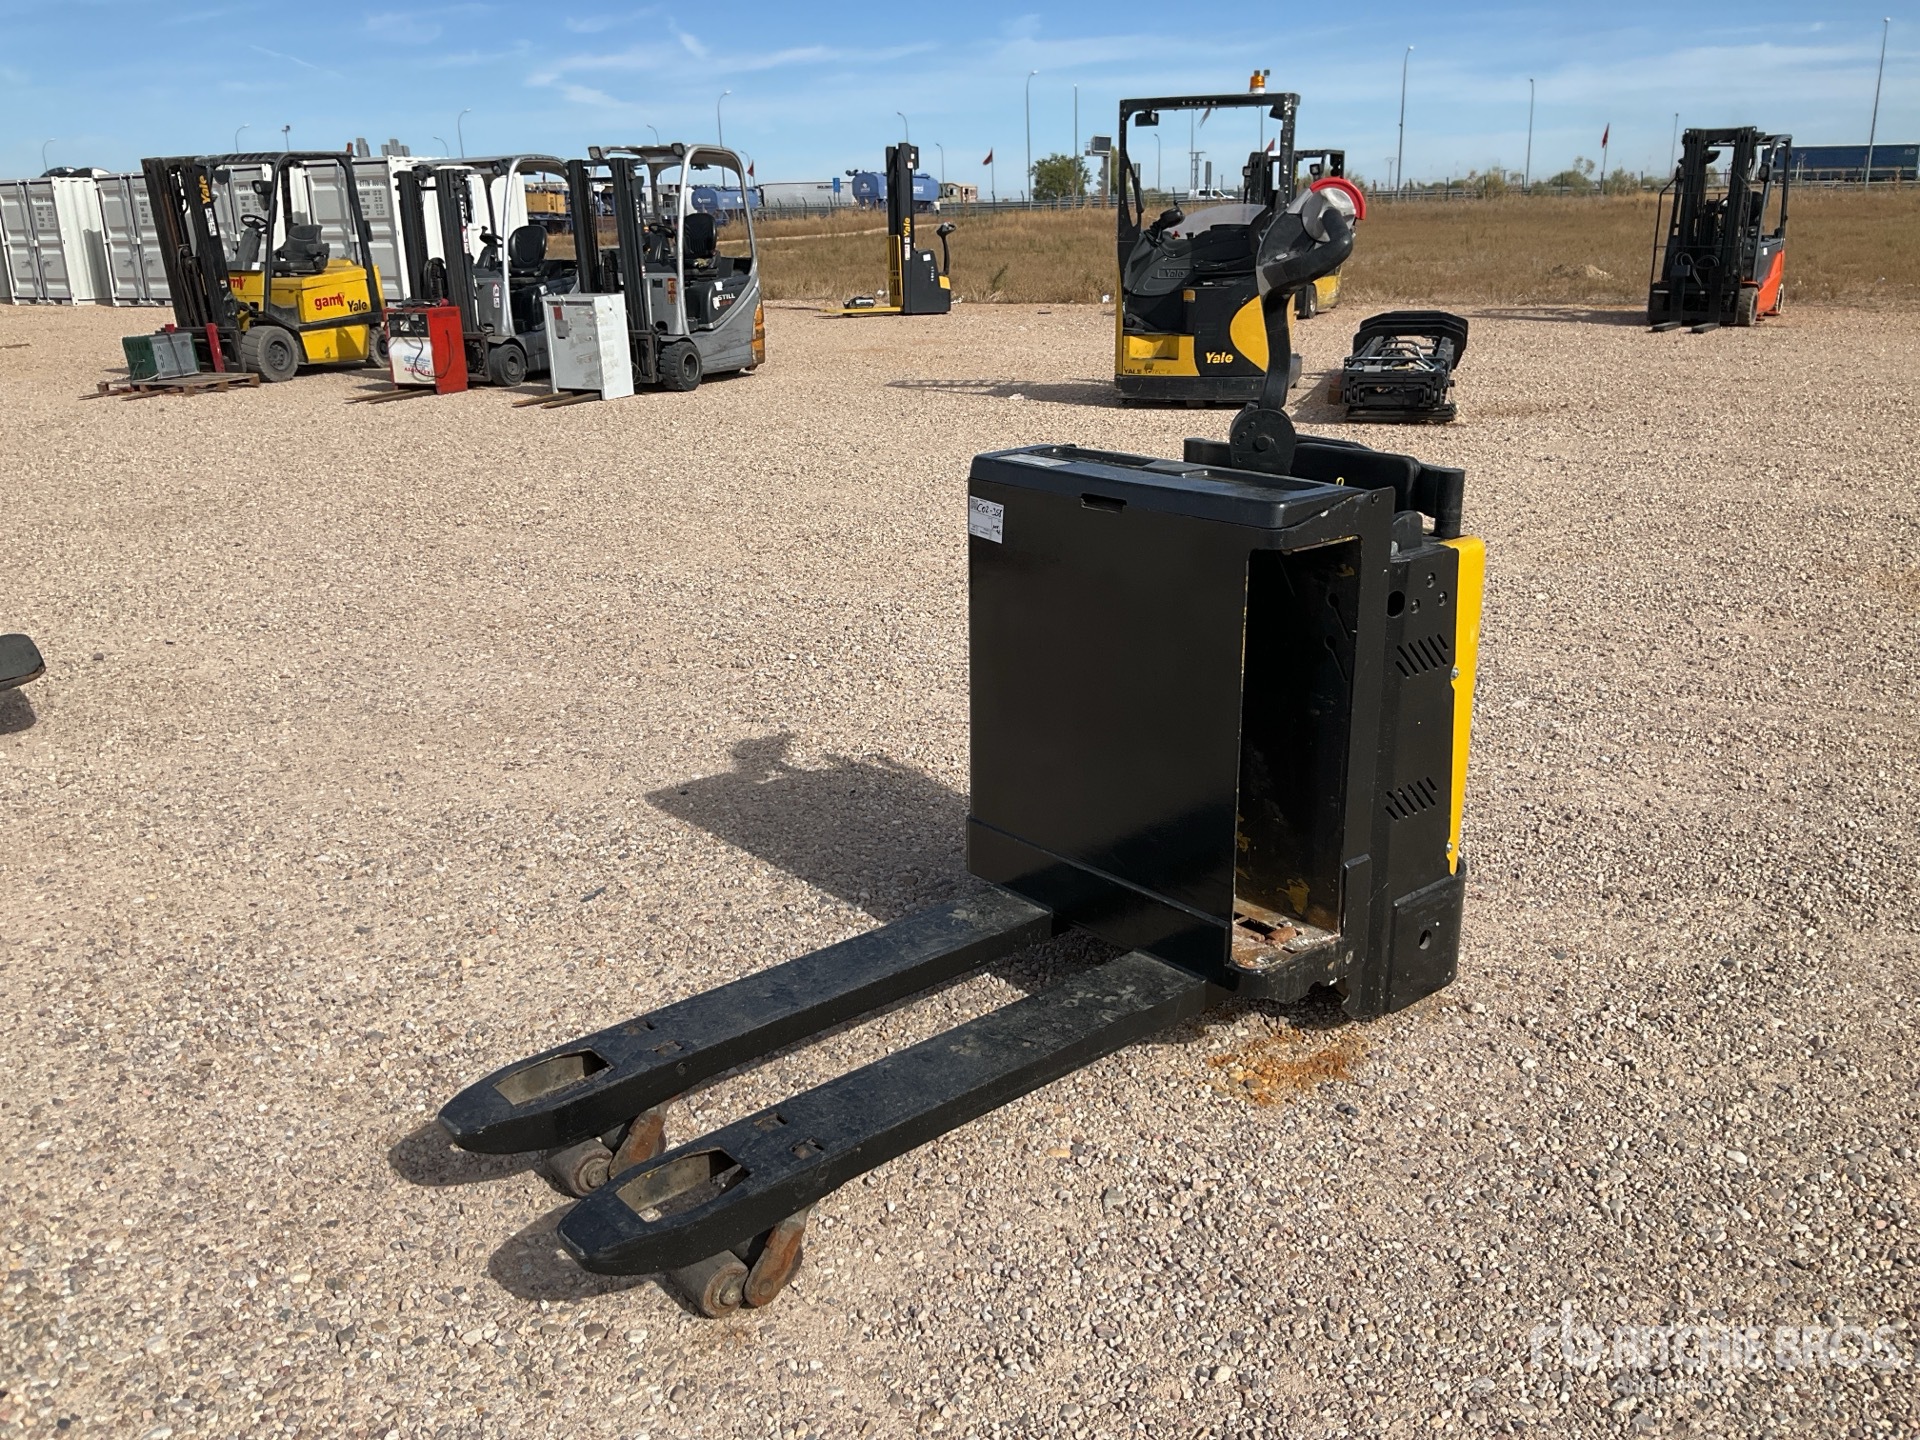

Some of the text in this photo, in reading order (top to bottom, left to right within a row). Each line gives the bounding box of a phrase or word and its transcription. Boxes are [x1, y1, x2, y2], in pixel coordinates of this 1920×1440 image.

[199, 175, 211, 204] Yale
[903, 217, 911, 236] Yale
[347, 300, 367, 313] Yale
[1205, 352, 1234, 364] Yale
